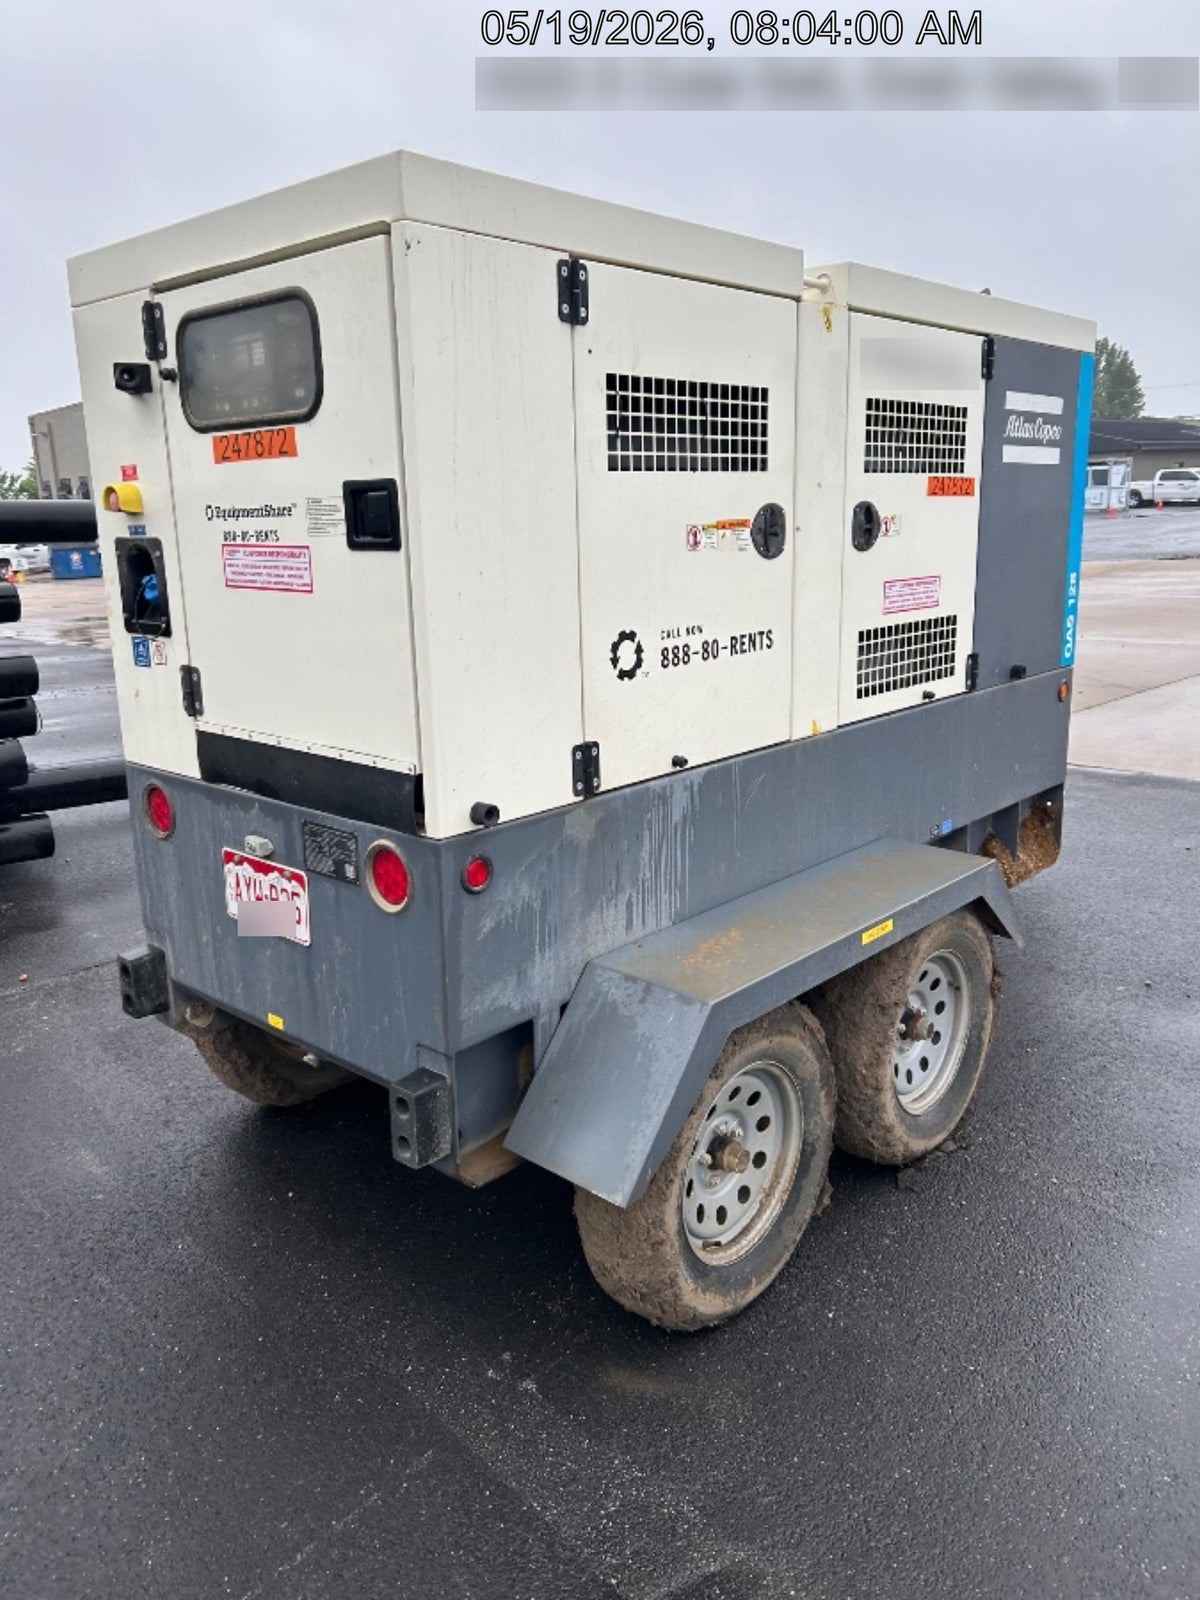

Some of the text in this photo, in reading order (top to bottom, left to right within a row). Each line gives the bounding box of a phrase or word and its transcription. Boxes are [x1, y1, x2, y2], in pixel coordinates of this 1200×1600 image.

[220, 427, 289, 461] 247872
[661, 624, 703, 641] CALL NOW
[661, 629, 774, 669] 888-80-RENTS
